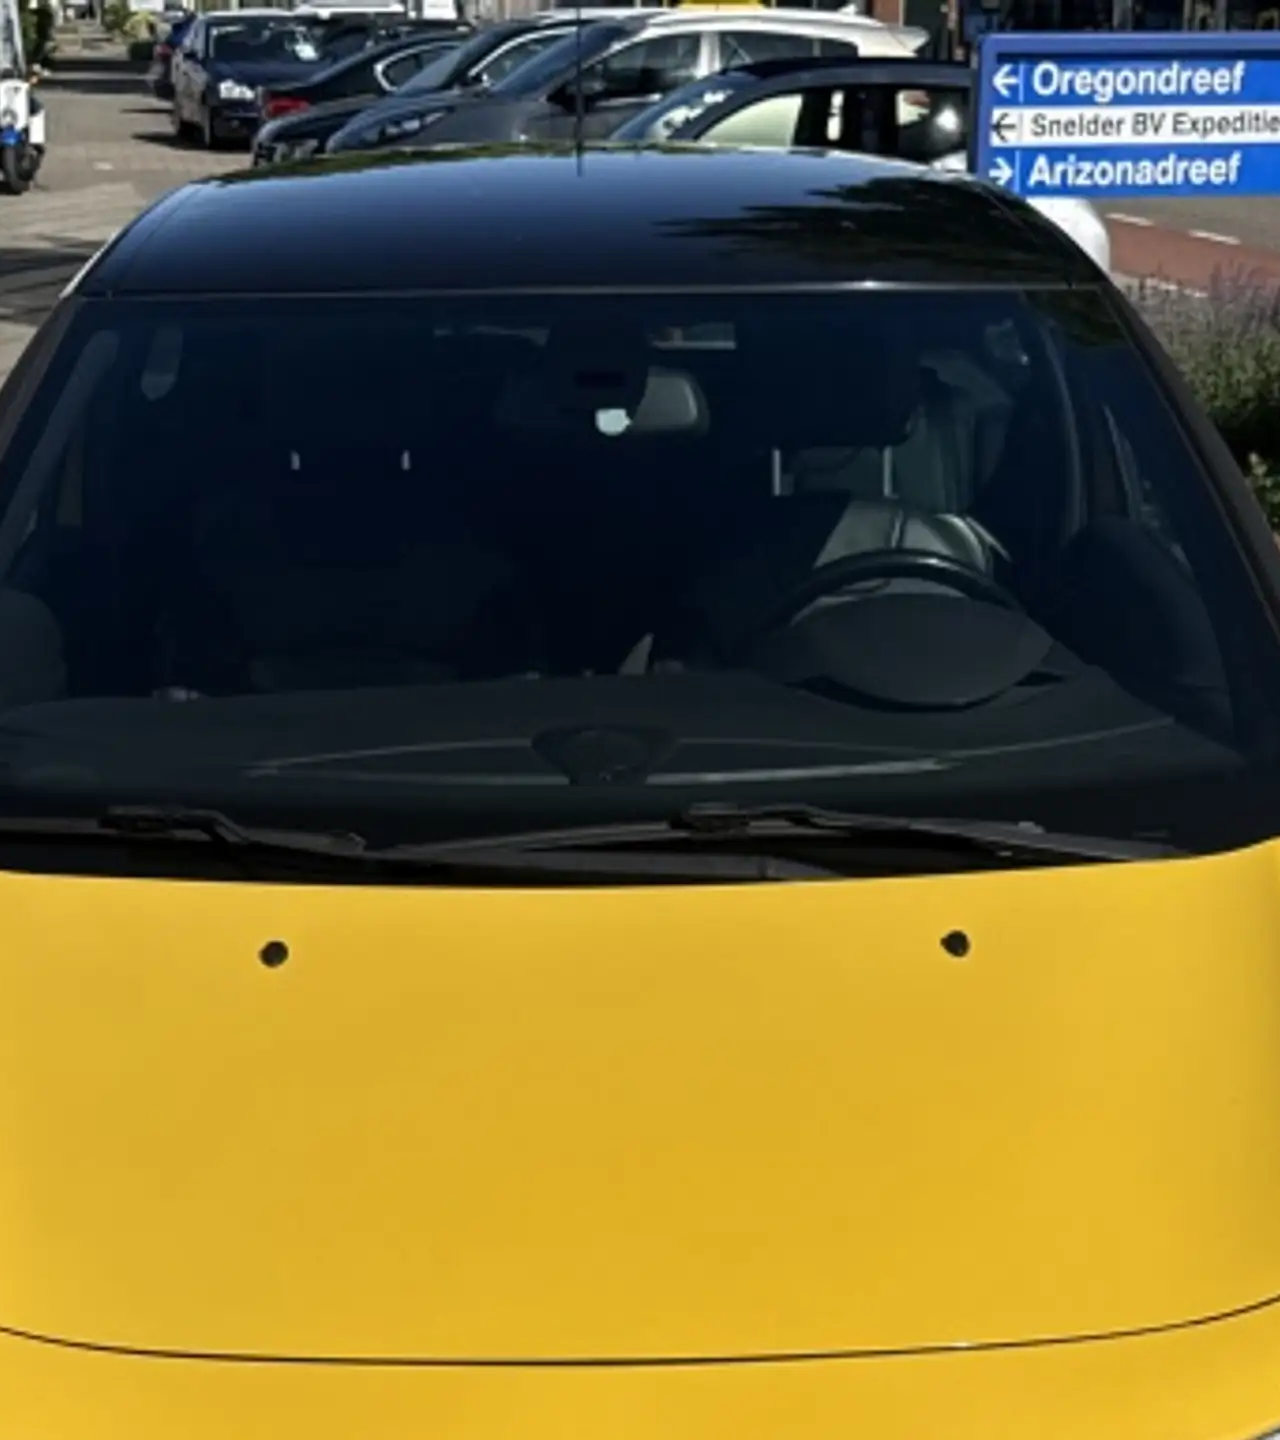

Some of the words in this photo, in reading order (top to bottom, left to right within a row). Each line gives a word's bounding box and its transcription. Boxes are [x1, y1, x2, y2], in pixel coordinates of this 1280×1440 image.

[1032, 60, 1245, 102] Oregondreef
[1031, 112, 1124, 138] Snelder
[1131, 112, 1167, 135] BV
[1027, 152, 1241, 187] Arizonadreef
